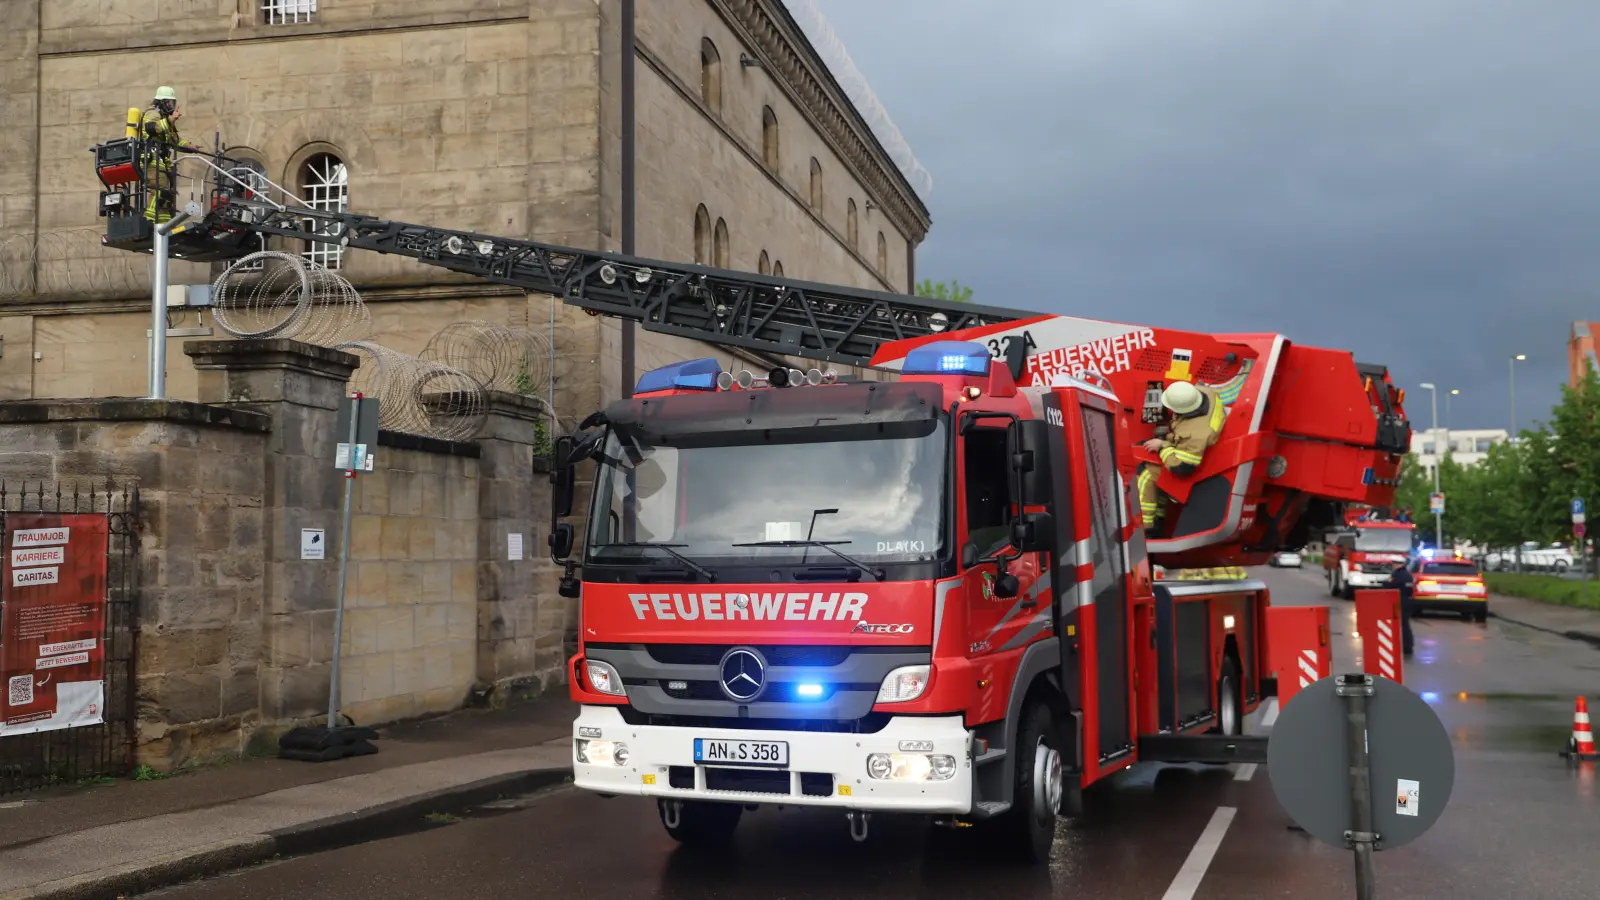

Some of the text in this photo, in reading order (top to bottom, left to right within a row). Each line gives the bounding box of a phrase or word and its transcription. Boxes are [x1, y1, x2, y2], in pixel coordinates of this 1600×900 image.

[1026, 329, 1157, 373] FEUERWEHR
[17, 531, 66, 542] TRAUMJOB.
[876, 541, 925, 552] DLA(K)
[16, 551, 61, 562] KARRIERE.
[17, 571, 55, 582] CARITAS.
[628, 593, 868, 620] FEUERWEHR
[55, 655, 87, 665] BEWERBEN
[708, 742, 779, 761] AN S 358
